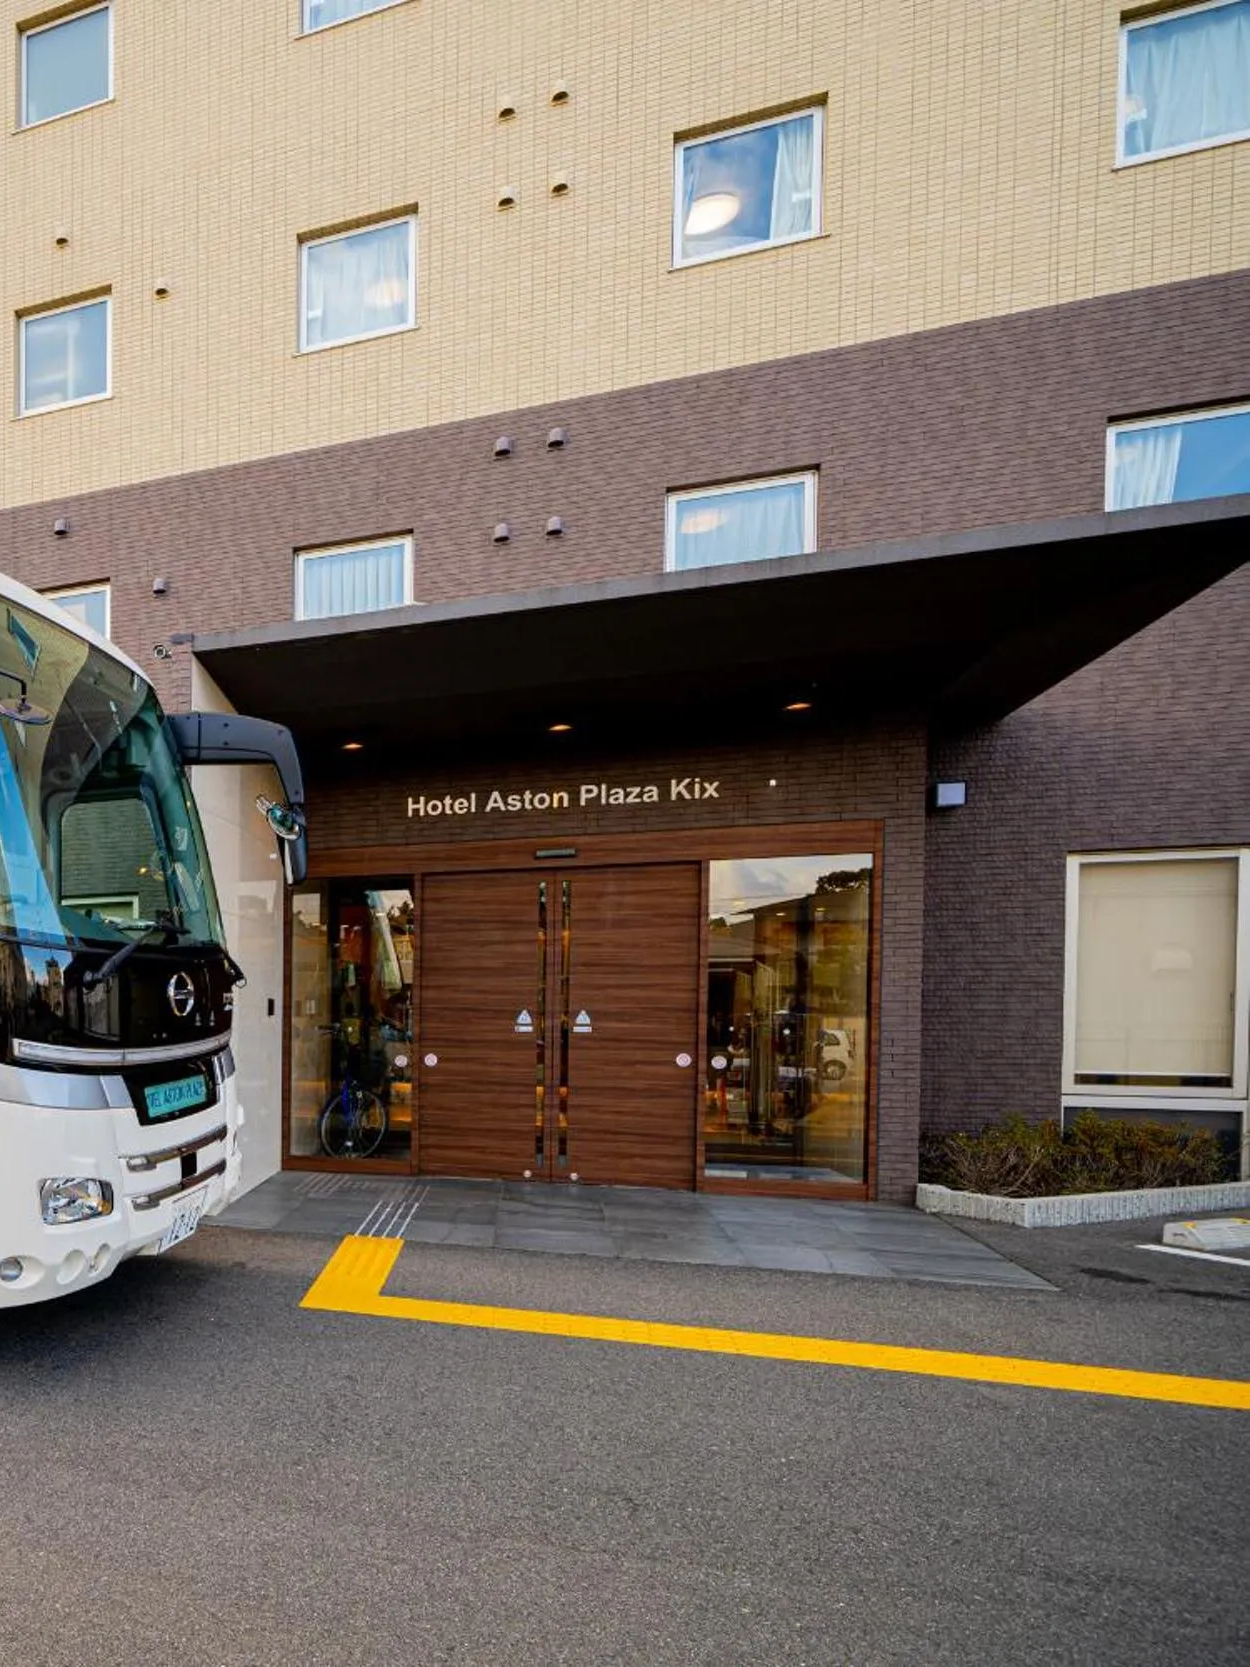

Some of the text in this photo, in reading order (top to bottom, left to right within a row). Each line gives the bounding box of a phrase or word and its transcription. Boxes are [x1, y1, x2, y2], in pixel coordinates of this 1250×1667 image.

[407, 777, 720, 818] Hotel Aston Plaza Kix
